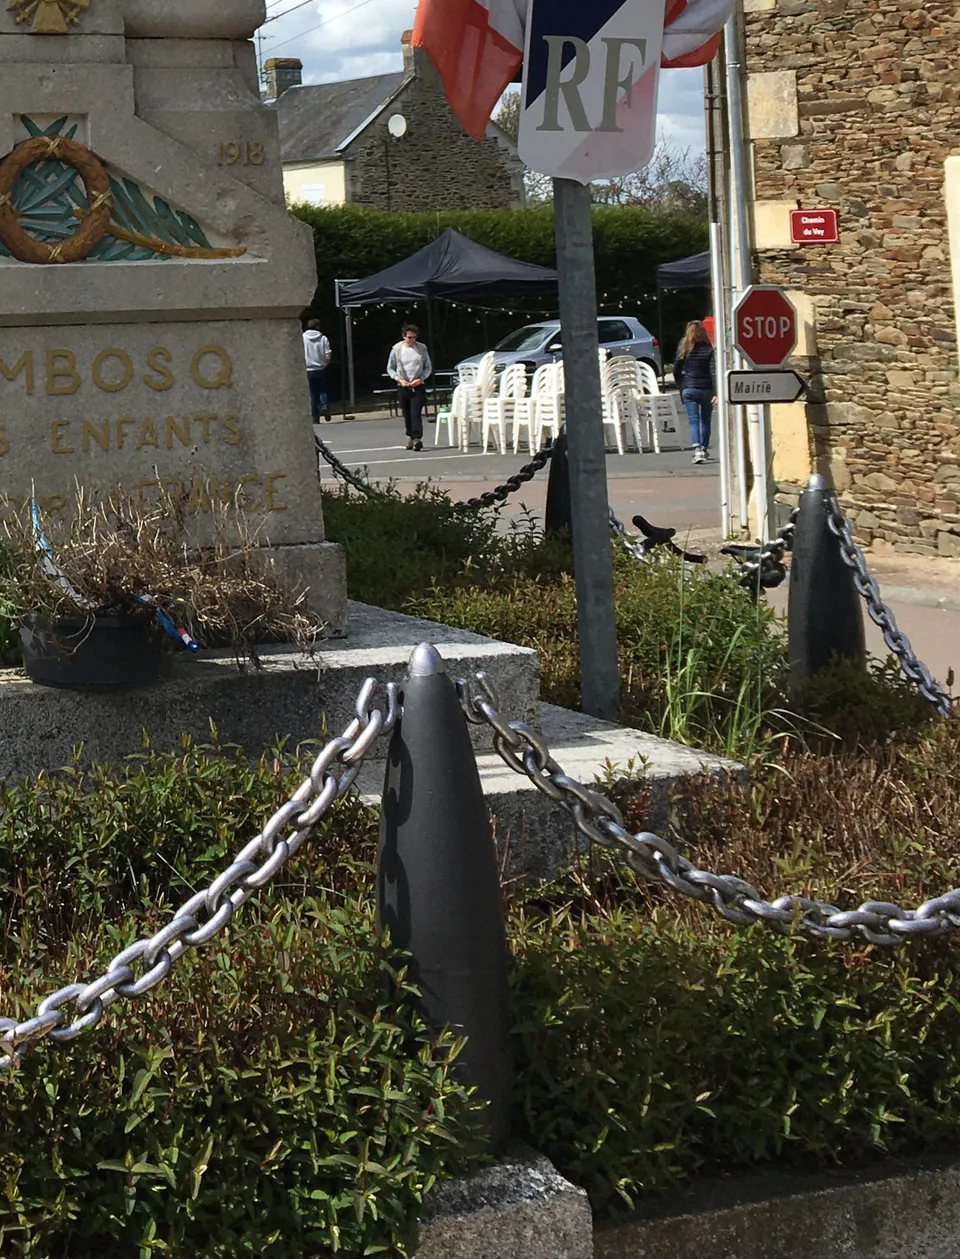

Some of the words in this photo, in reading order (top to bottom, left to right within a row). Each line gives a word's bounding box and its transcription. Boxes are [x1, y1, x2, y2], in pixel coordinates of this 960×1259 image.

[536, 35, 647, 132] RF
[216, 140, 266, 167] 1918
[800, 216, 825, 225] Chemin
[803, 228, 812, 236] du
[742, 316, 791, 339] STOP
[734, 380, 772, 394] Mairie
[50, 413, 242, 454] ENFANTS
